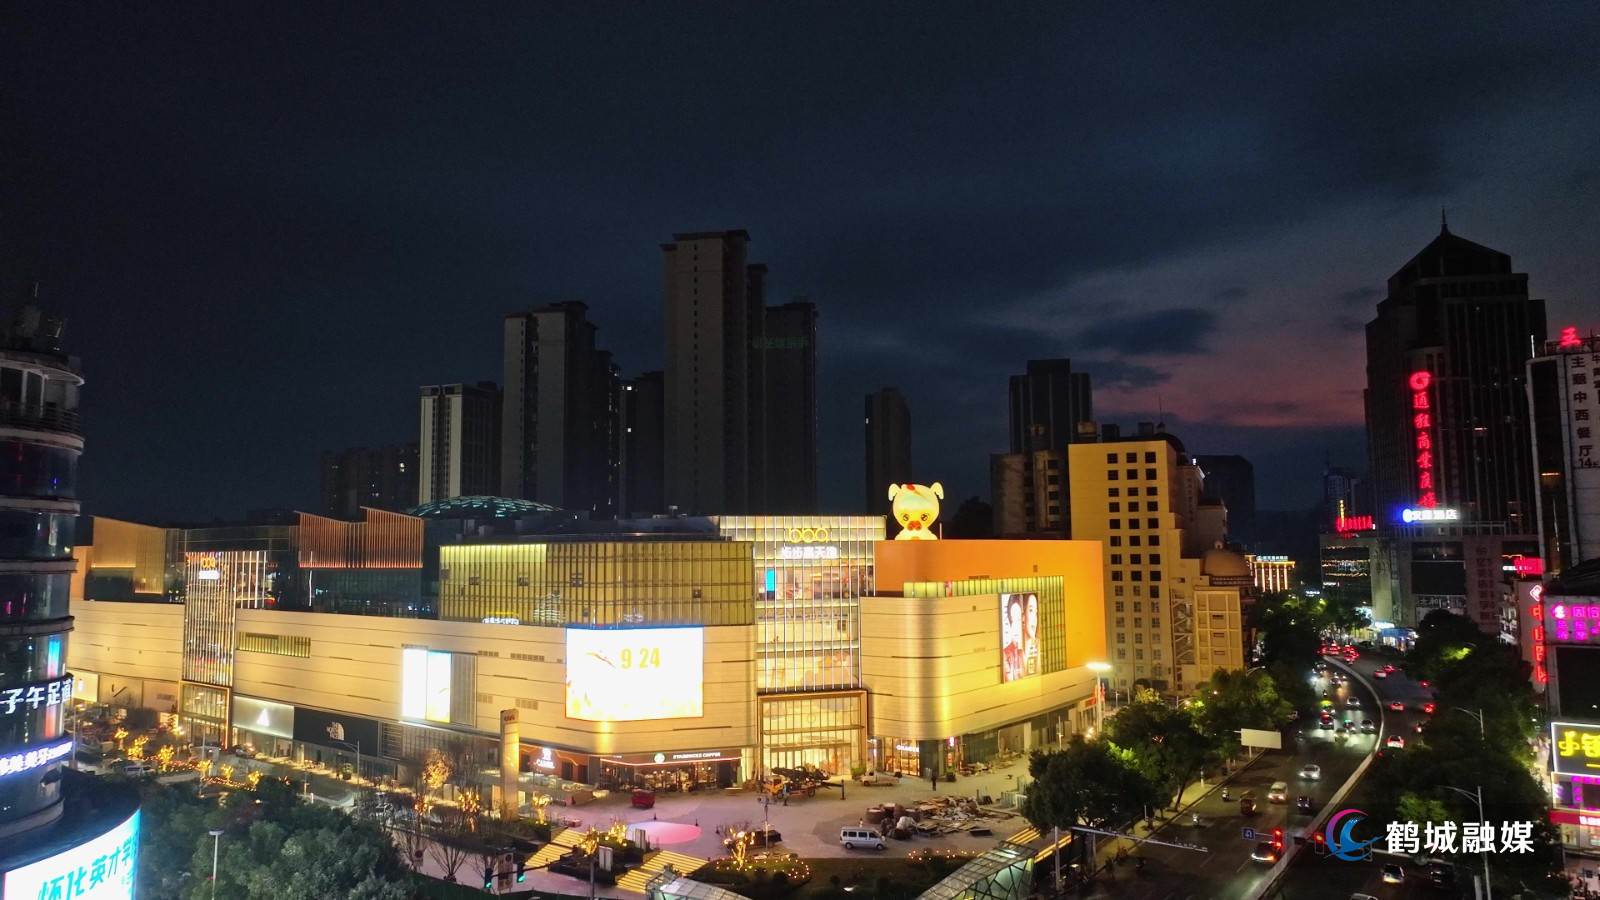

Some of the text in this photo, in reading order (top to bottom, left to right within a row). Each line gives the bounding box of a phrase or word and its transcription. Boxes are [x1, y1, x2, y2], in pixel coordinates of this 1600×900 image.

[1571, 356, 1593, 458] 主题中西餐厅
[620, 647, 661, 669] 9 24
